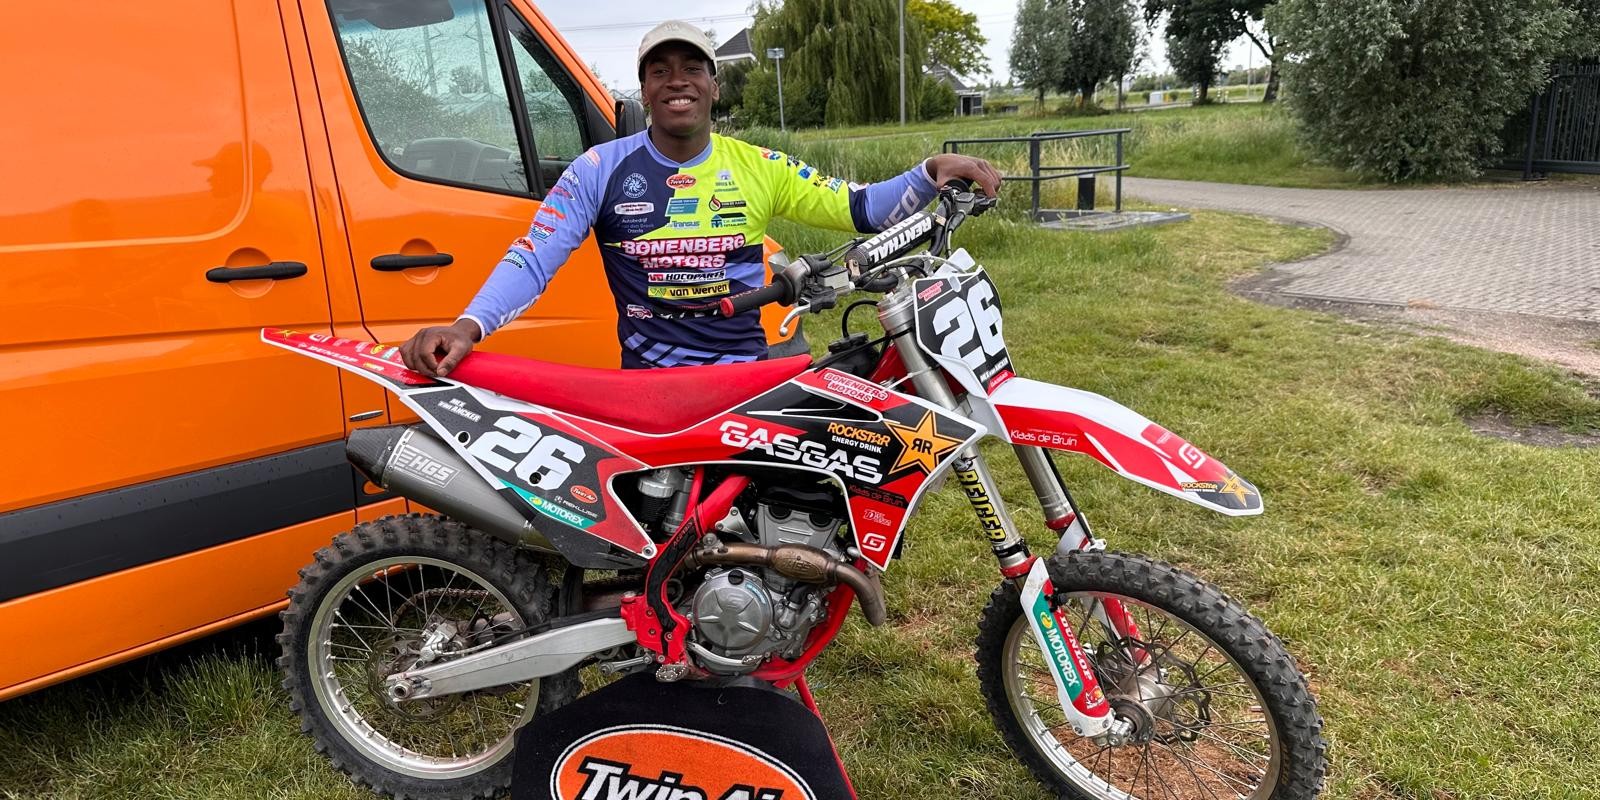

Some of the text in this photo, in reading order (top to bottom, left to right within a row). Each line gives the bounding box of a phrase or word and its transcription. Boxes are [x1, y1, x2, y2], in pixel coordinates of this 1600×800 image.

[621, 235, 745, 255] BONENBERG
[868, 216, 932, 263] RENTHAL
[640, 254, 726, 269] MOTORS
[666, 270, 725, 280] HOCOPARTS
[670, 288, 689, 296] van
[692, 283, 728, 295] werven
[933, 279, 1003, 372] 26
[306, 345, 358, 363] DUNLOP
[823, 372, 889, 400] BONENBERG
[827, 381, 873, 403] MOTORS
[827, 422, 891, 447] ROCKSTAR
[831, 435, 883, 454] ENERGY DRINK
[1010, 429, 1036, 442] Klaas
[1037, 433, 1051, 443] de
[1052, 434, 1078, 447] Bruin
[467, 415, 587, 491] 26
[719, 420, 883, 485] GASGAS
[409, 455, 455, 481] HGS
[573, 488, 587, 498] Twin
[541, 500, 585, 527] MOTOREX
[1046, 628, 1080, 688] MOTOREX
[1060, 613, 1093, 681] DUNLOP
